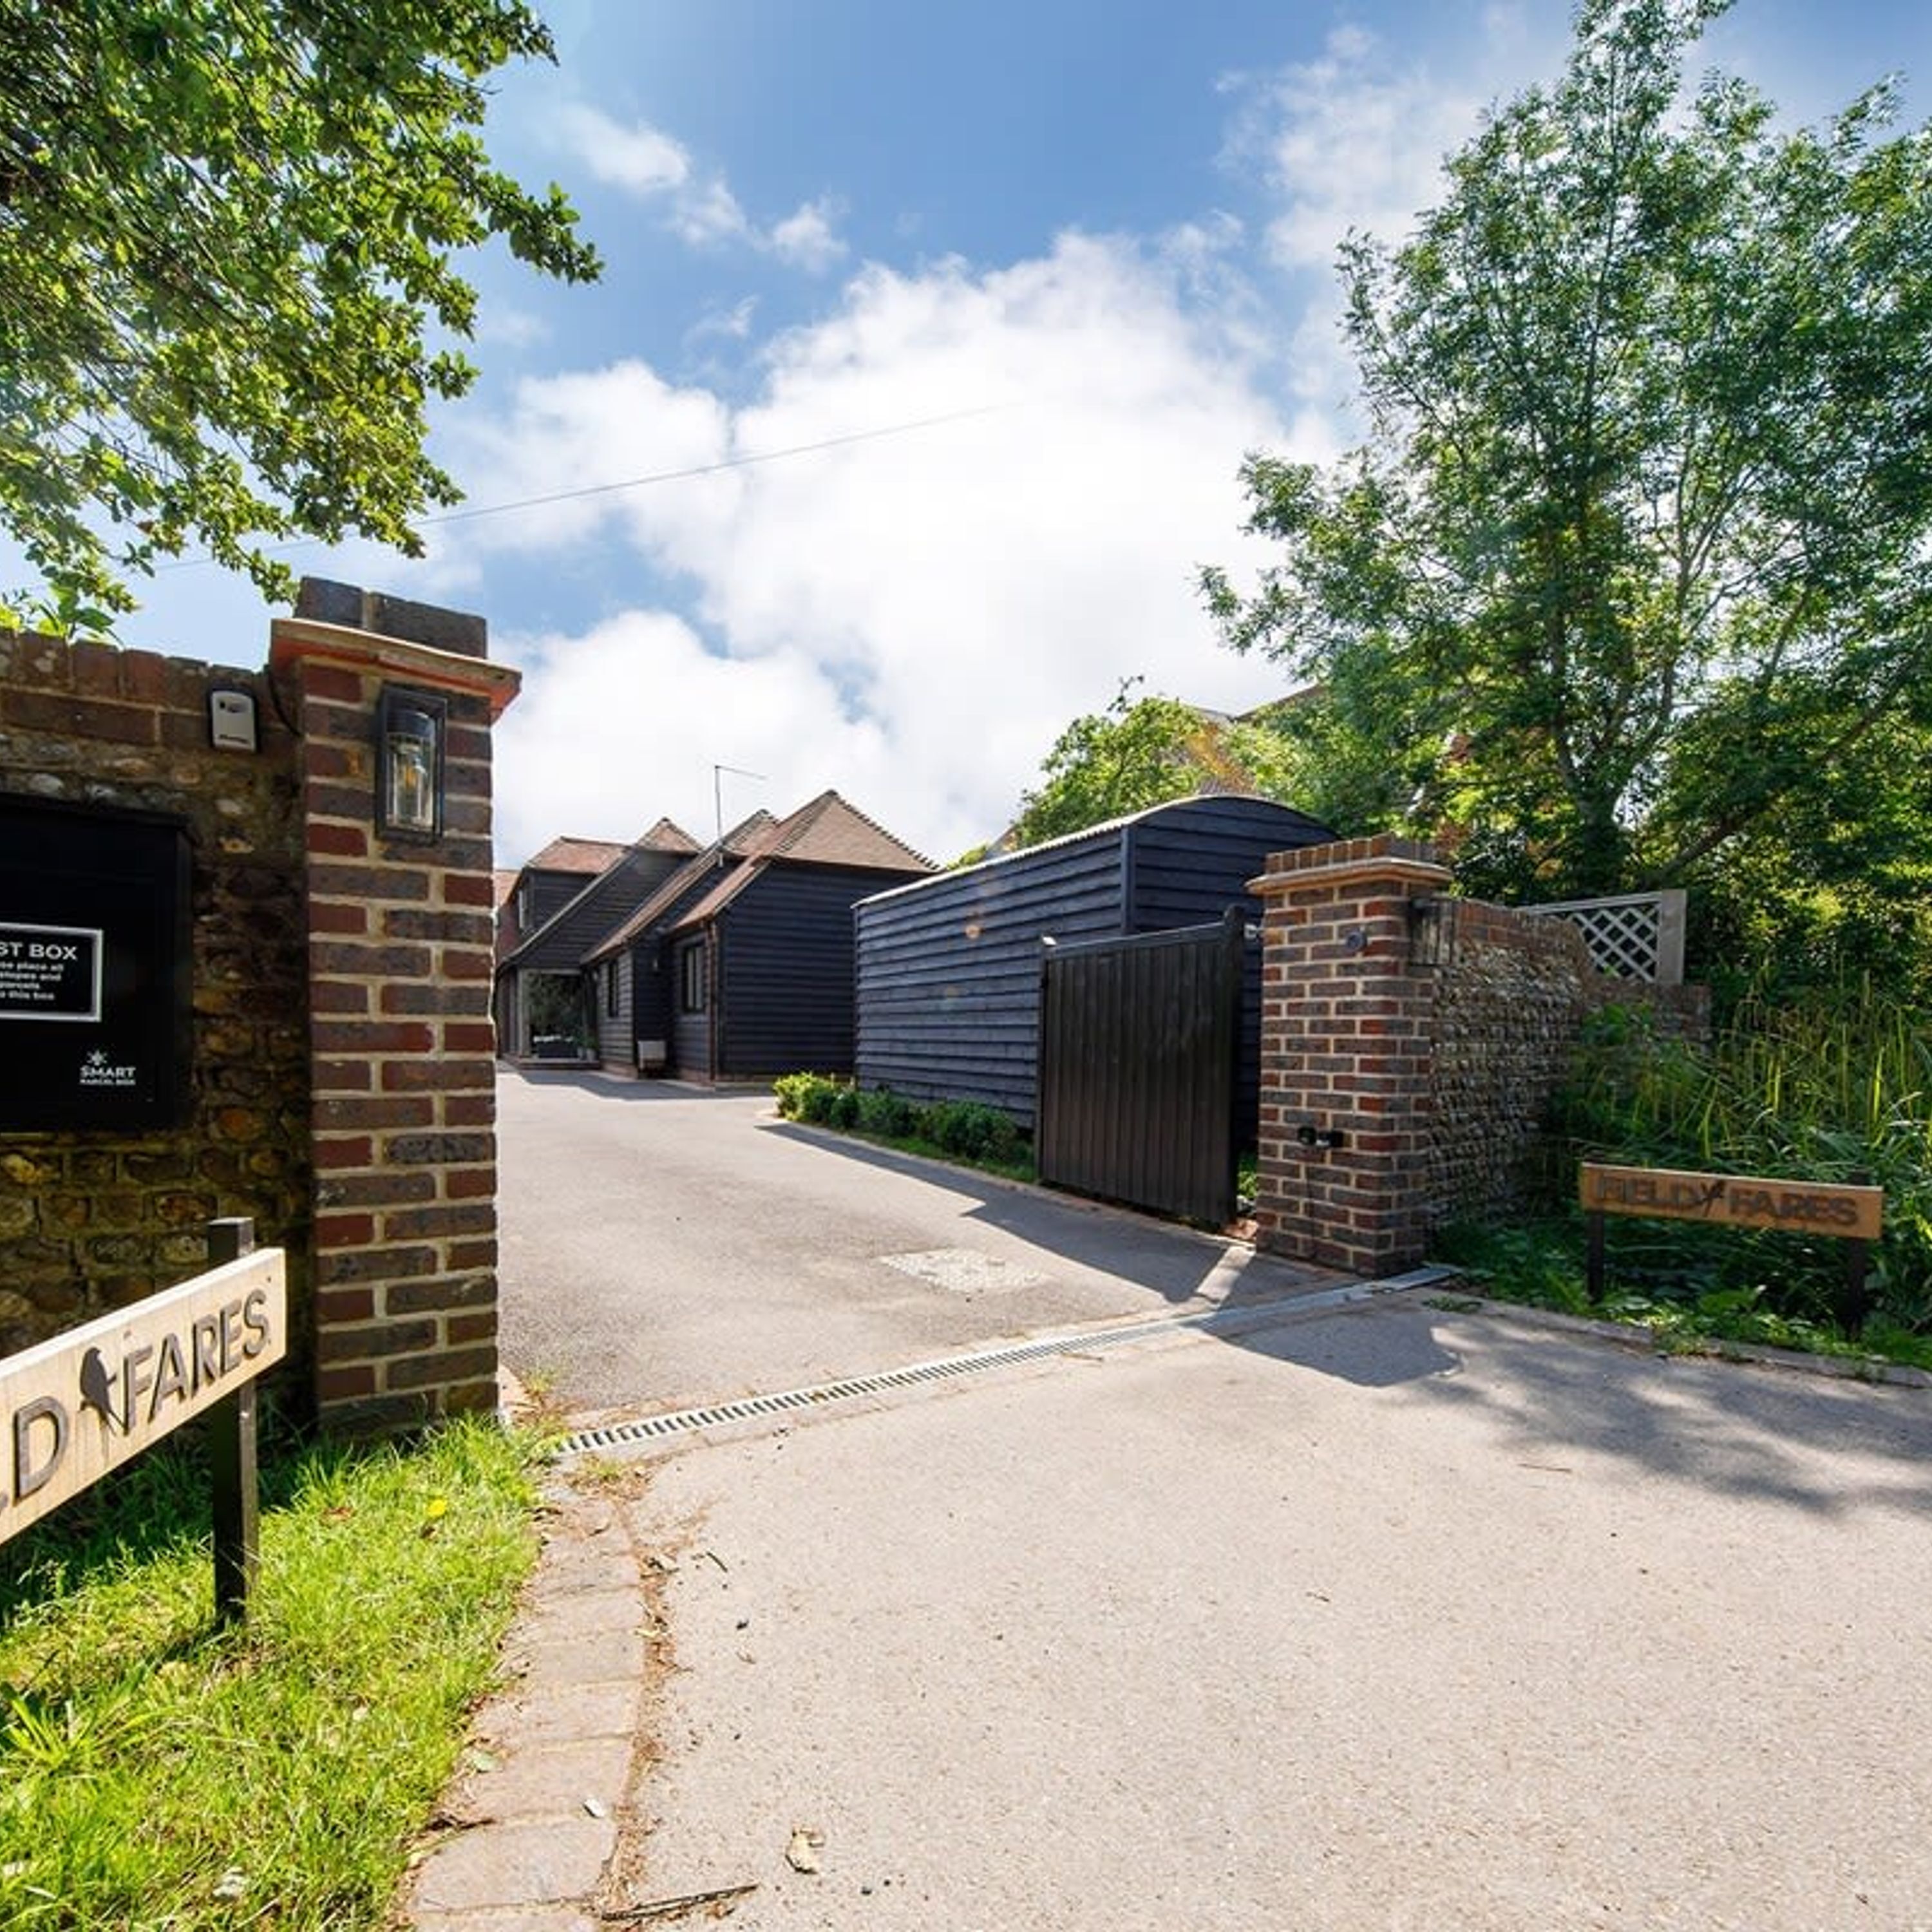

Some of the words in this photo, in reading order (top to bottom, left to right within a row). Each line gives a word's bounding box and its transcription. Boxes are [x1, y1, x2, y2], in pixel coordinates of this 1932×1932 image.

[28, 943, 77, 960] BOX
[80, 1066, 136, 1079] SMART
[1598, 1173, 1701, 1211] FIELD
[1728, 1188, 1858, 1225] FARES
[123, 1289, 270, 1437] FARES
